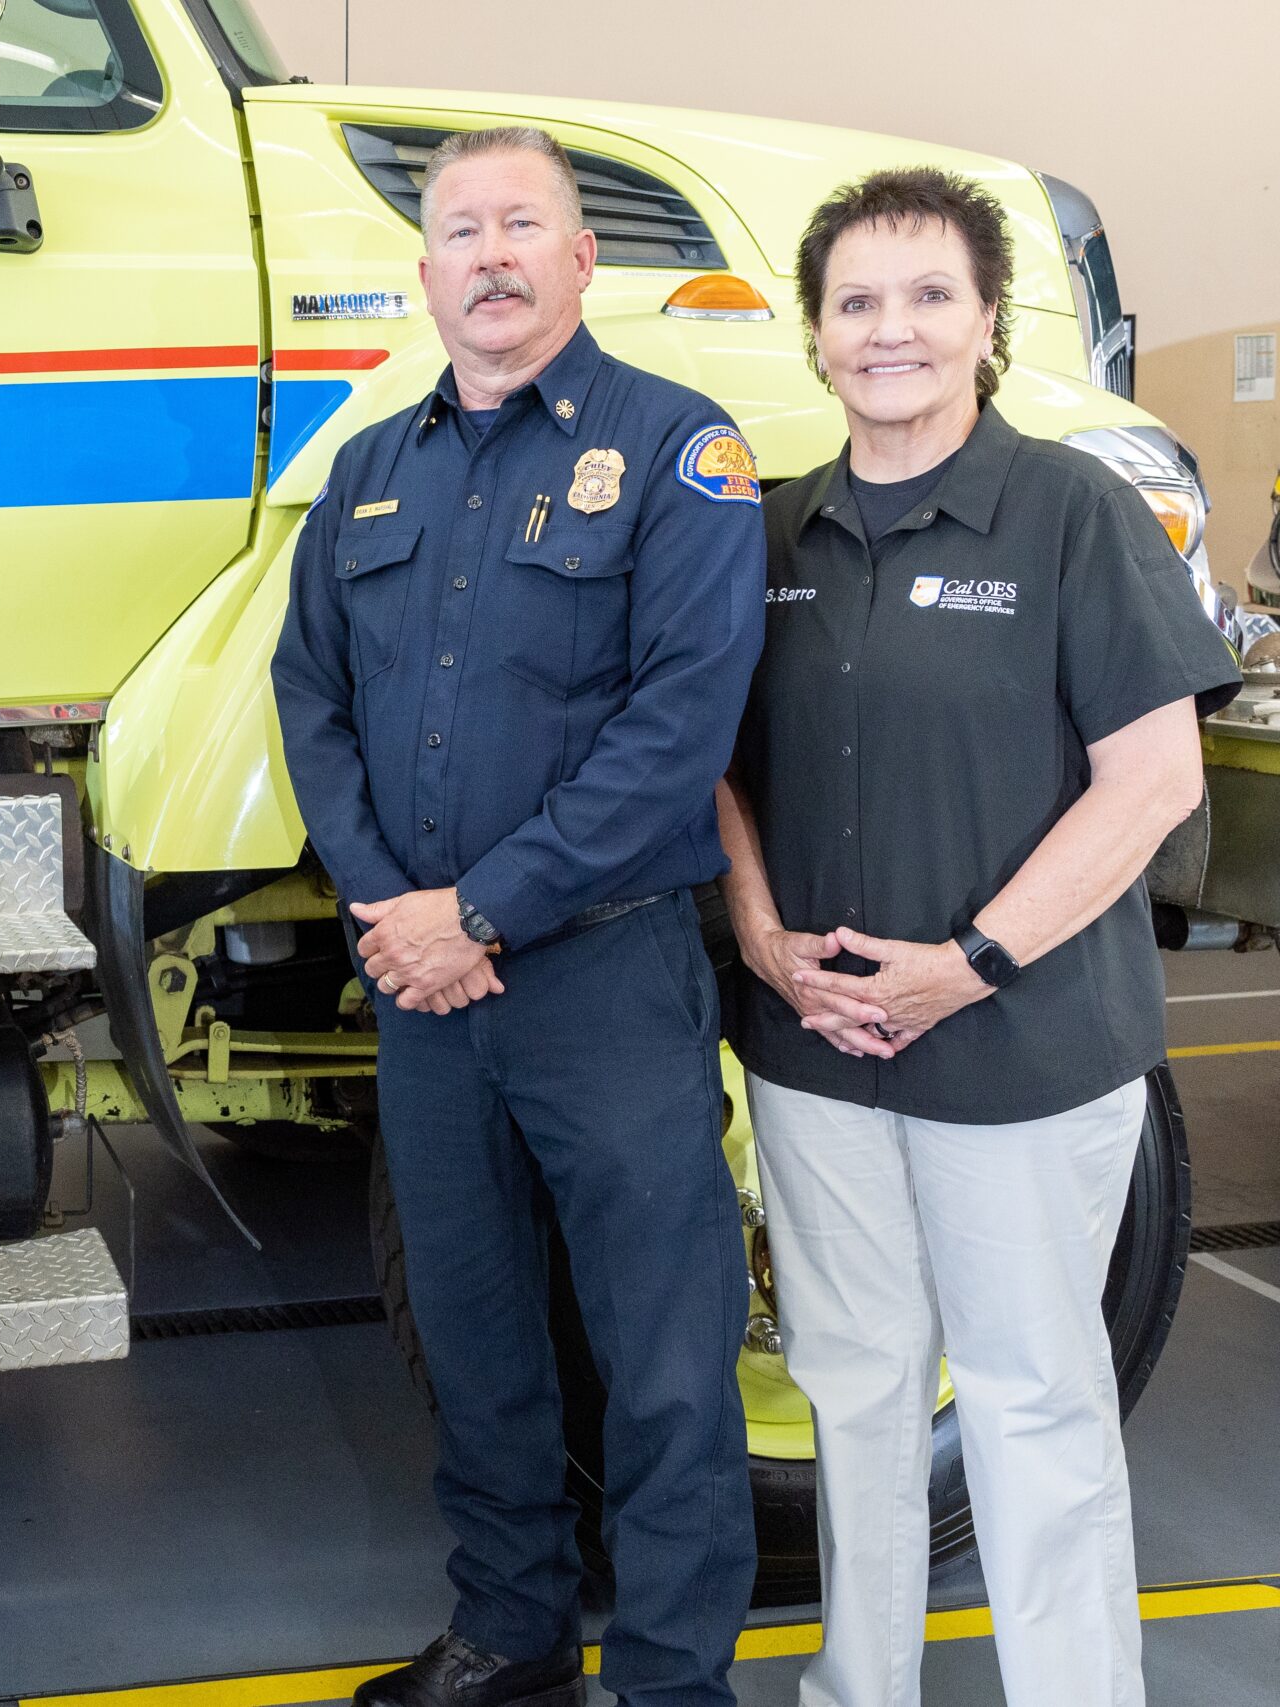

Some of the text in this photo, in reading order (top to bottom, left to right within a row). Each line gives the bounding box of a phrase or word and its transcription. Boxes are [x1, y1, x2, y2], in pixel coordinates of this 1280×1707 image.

[714, 441, 742, 453] OES
[727, 475, 751, 487] FIRE
[943, 579, 1017, 599] Cal OES
[940, 596, 1002, 607] GOVERNOR'S OFFICE
[947, 603, 984, 612] EMERGENCY
[984, 606, 1015, 615] SERVICES
